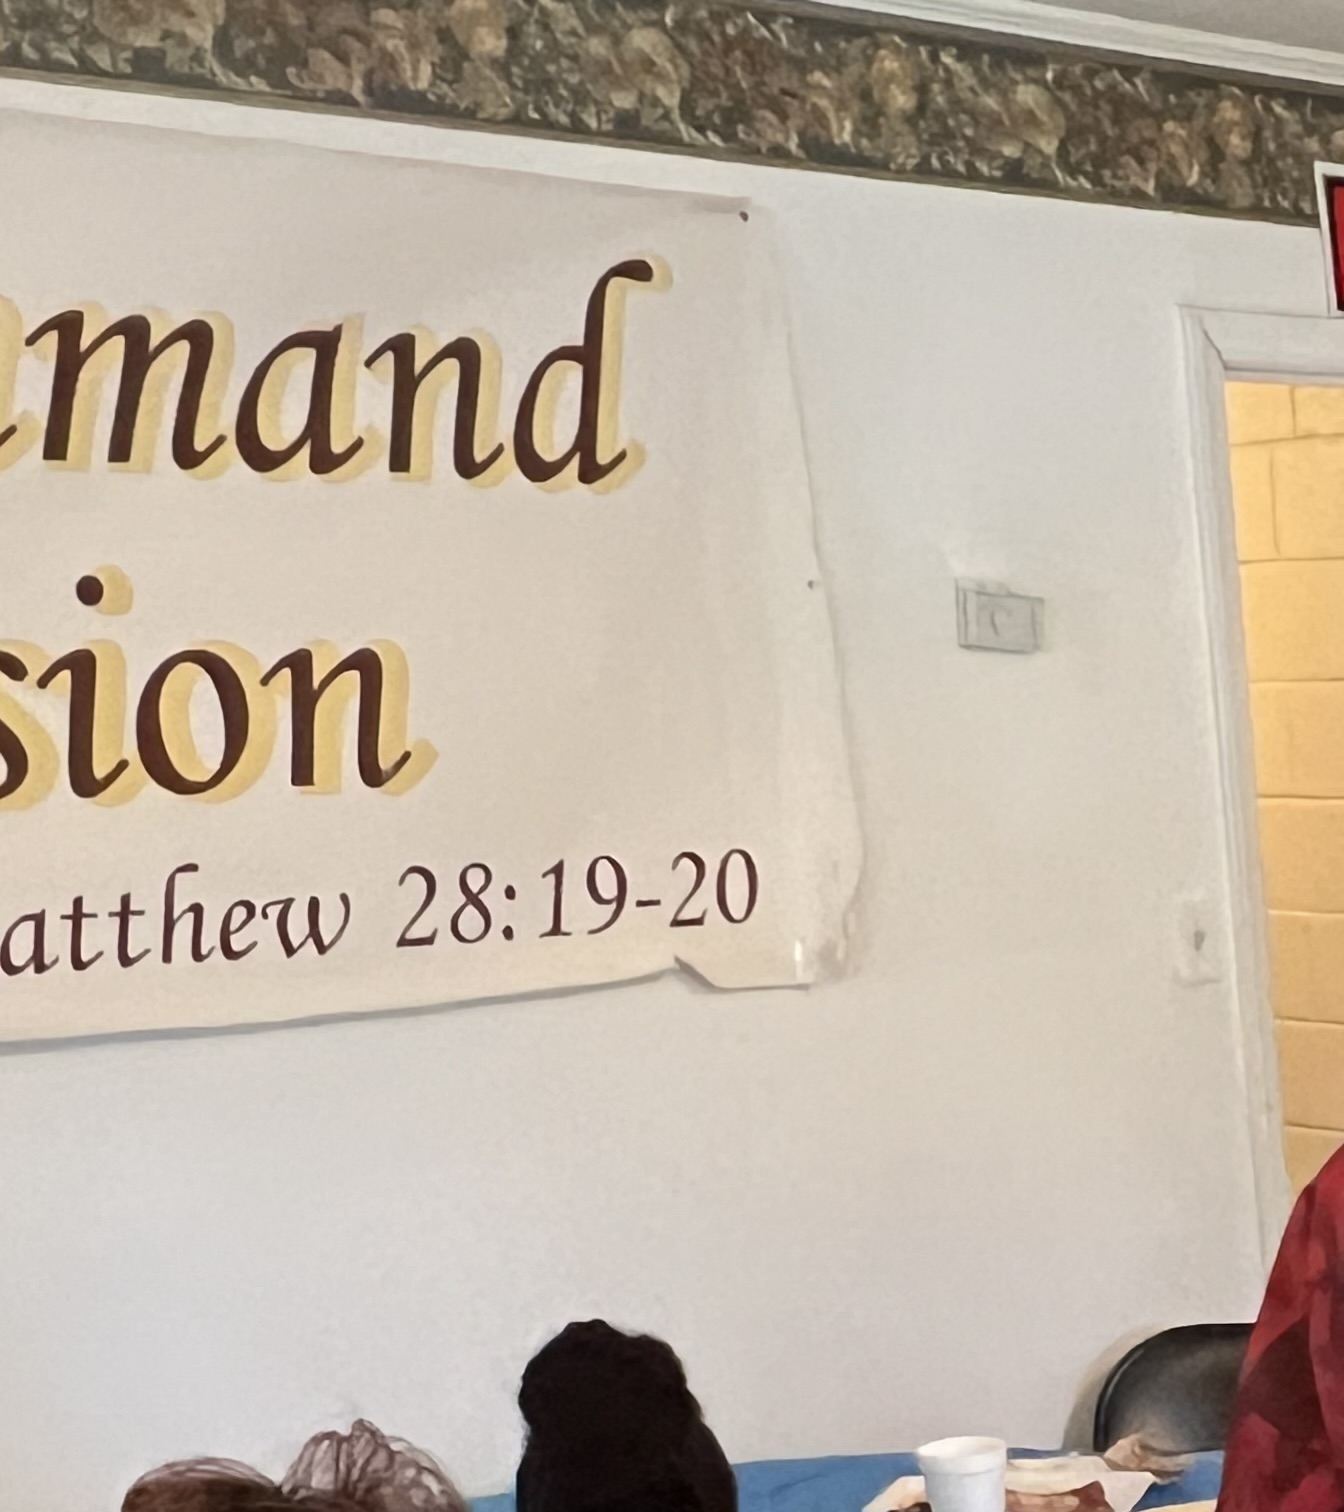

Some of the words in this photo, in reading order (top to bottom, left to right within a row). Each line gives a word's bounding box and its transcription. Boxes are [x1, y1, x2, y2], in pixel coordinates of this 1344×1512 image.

[0, 256, 664, 488] mand
[0, 862, 351, 977] atthew
[396, 848, 759, 948] 28:19-20
